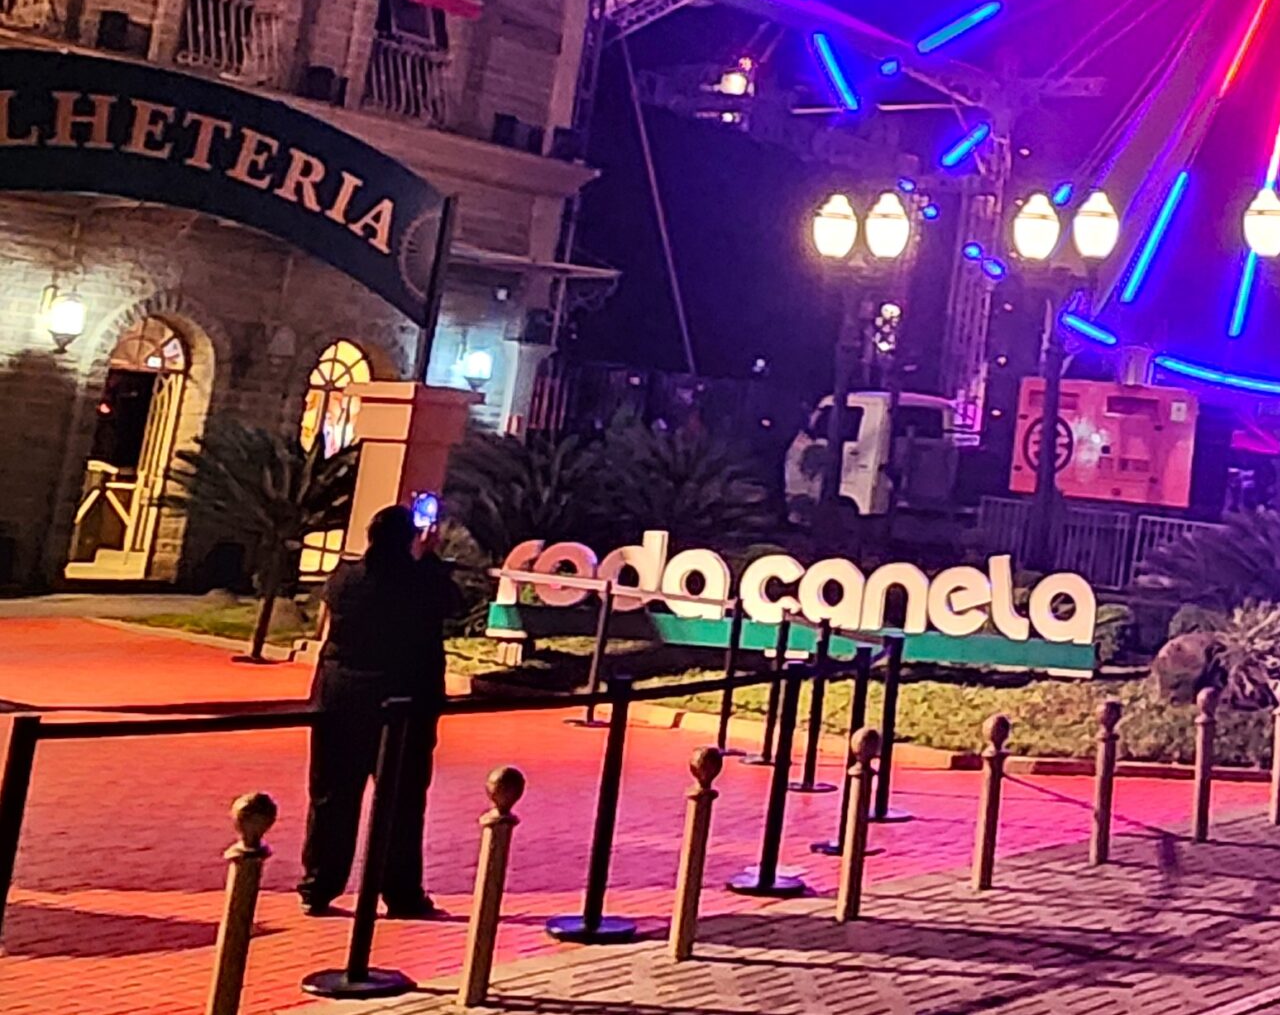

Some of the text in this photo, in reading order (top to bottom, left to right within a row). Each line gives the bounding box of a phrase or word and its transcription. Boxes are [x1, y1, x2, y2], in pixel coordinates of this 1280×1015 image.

[0, 90, 396, 253] LHETERIA
[496, 530, 1096, 644] roda canela
